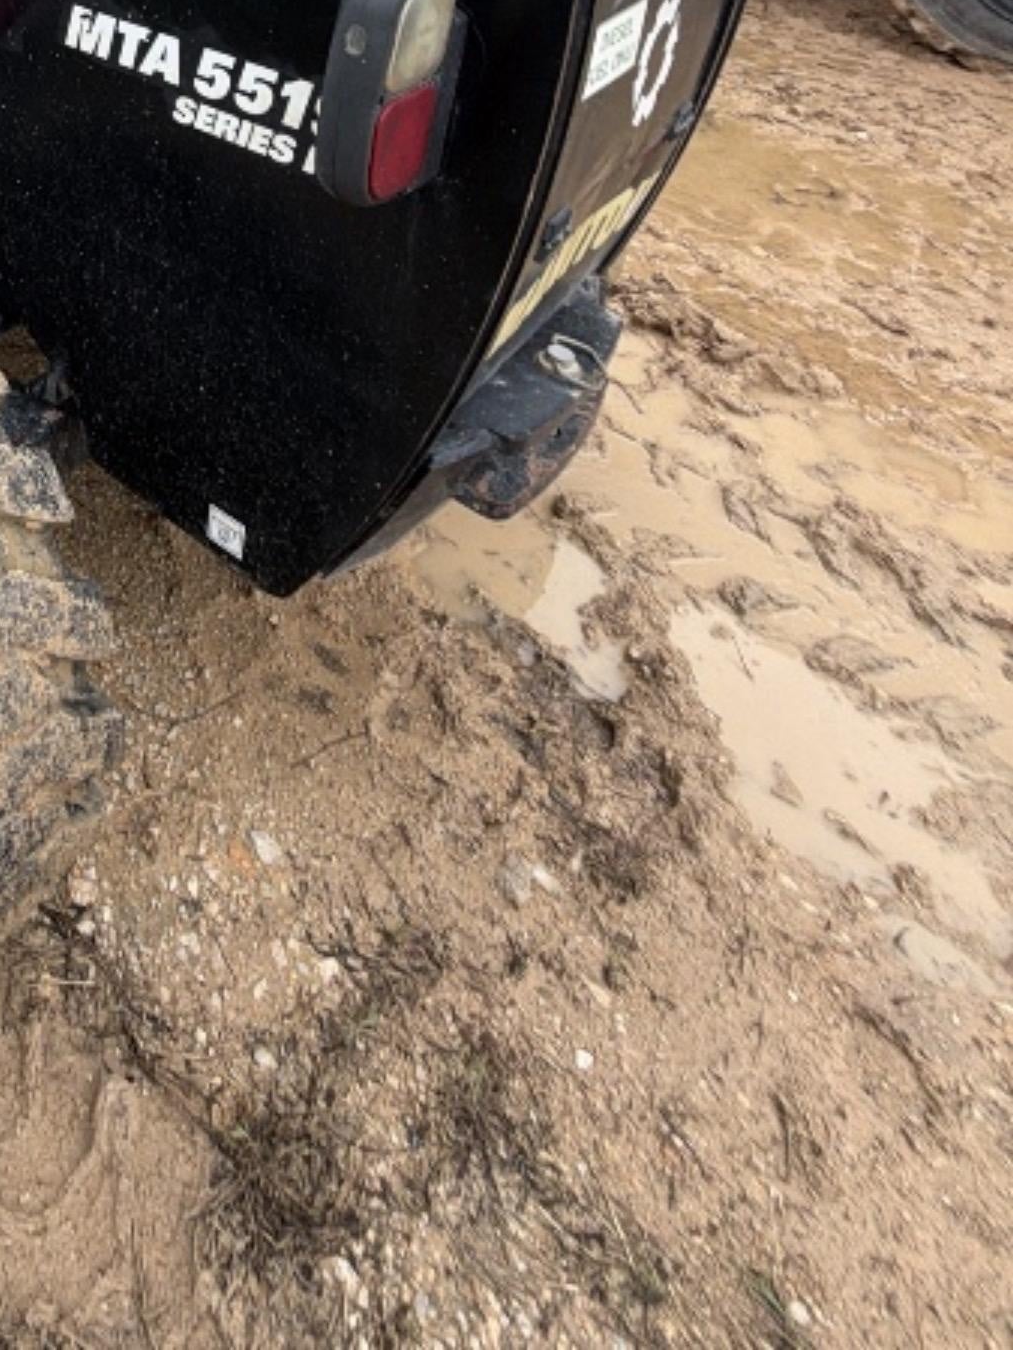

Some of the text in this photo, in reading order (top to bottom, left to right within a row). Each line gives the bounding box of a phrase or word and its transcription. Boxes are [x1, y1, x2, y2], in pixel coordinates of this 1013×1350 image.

[64, 4, 322, 137] MTA 551
[171, 95, 297, 165] SERIES
